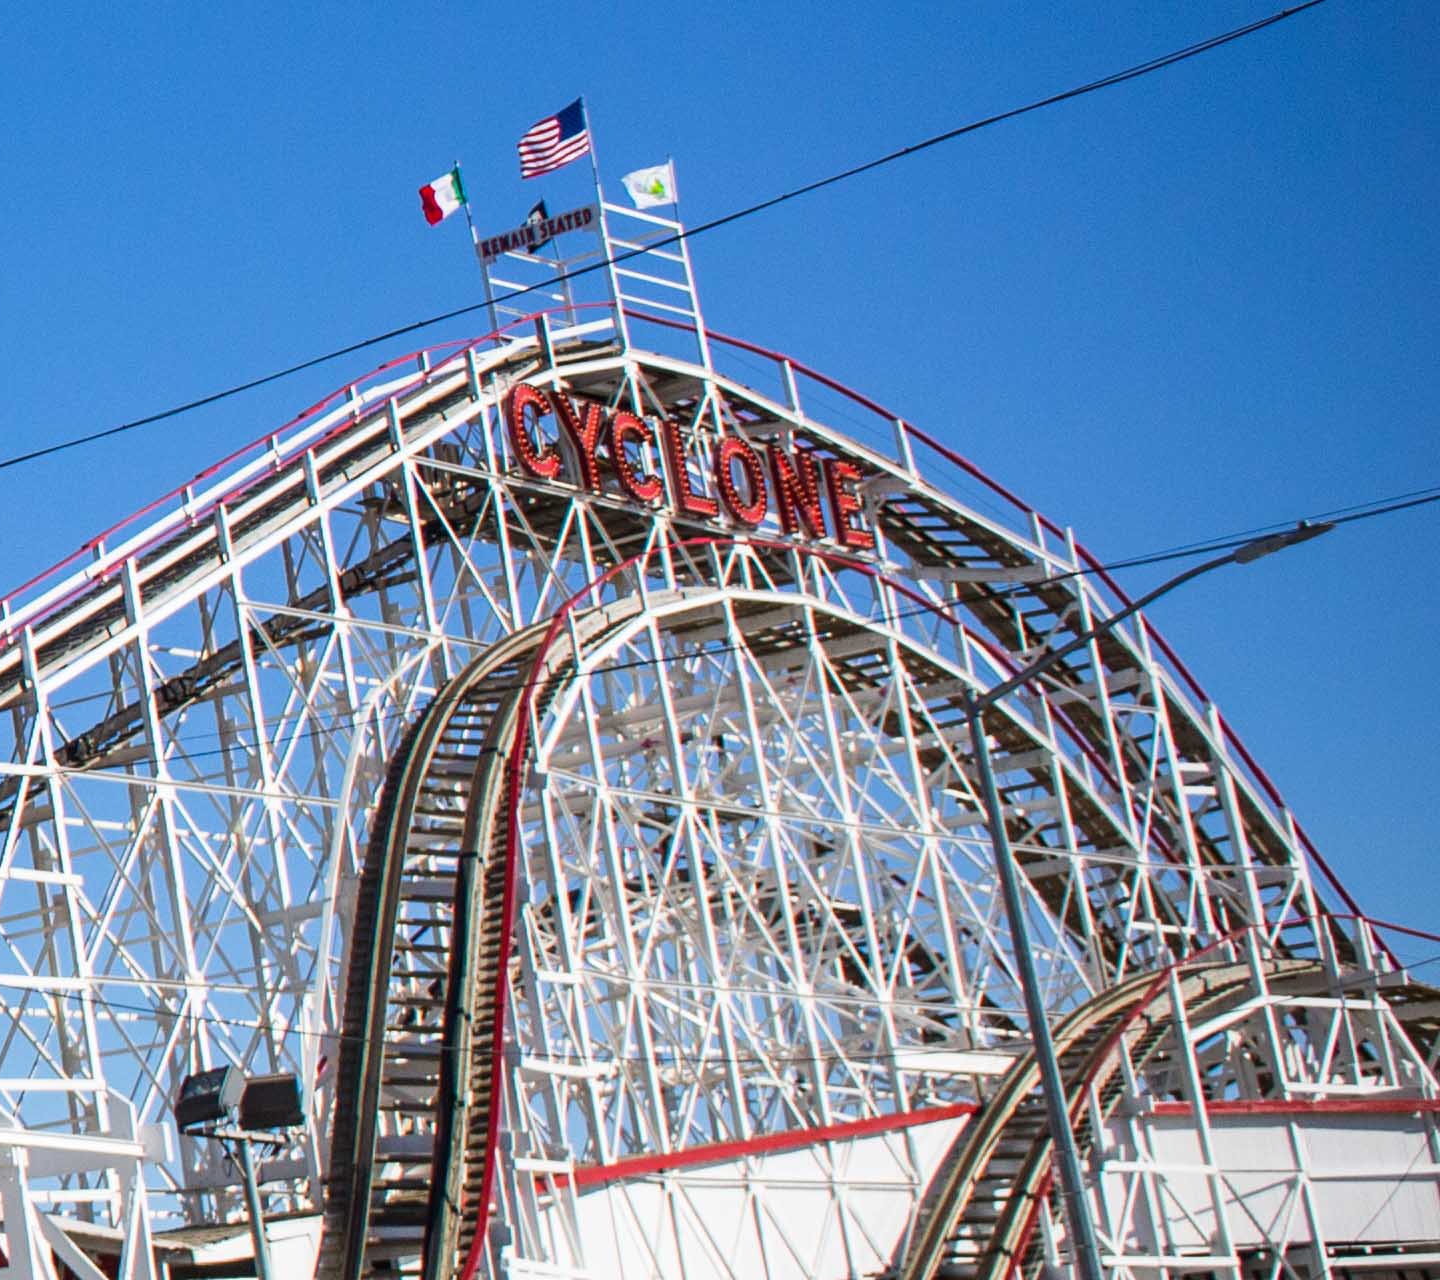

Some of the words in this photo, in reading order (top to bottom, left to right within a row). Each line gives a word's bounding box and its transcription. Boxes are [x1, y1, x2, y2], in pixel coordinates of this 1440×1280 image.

[481, 227, 535, 259] REMAIN
[539, 207, 592, 239] SEATED
[506, 382, 876, 549] CYCLONE
